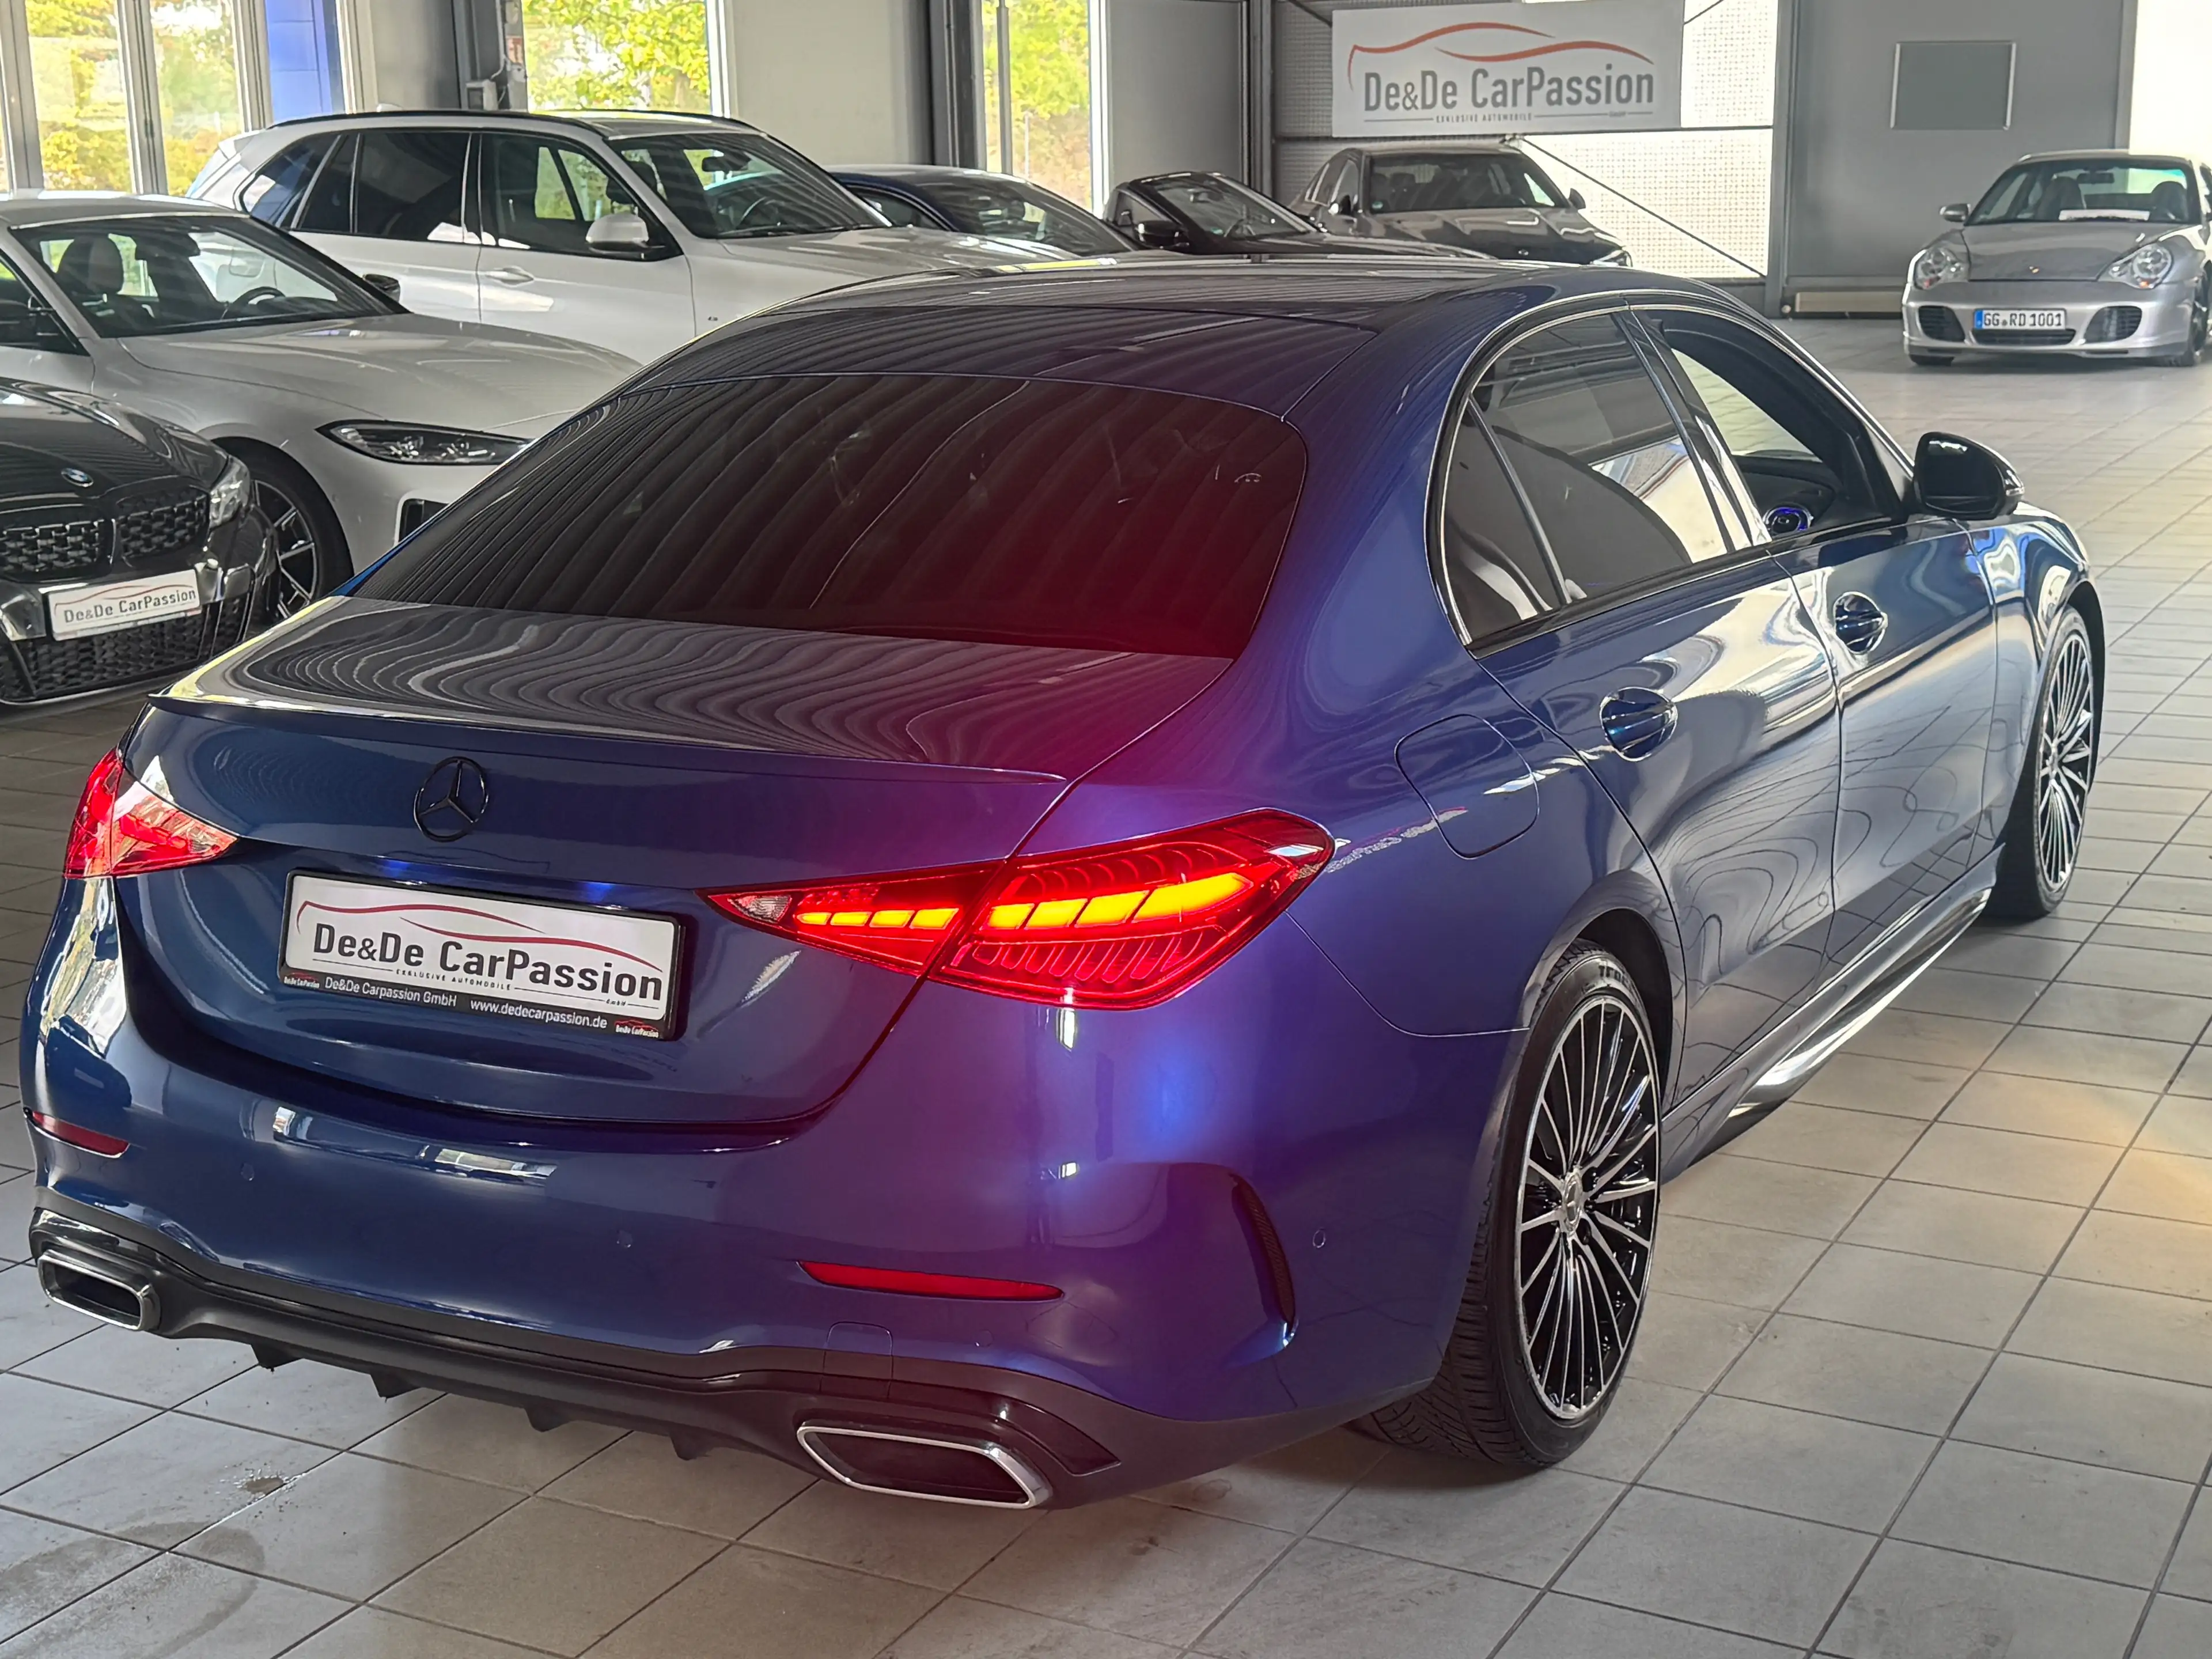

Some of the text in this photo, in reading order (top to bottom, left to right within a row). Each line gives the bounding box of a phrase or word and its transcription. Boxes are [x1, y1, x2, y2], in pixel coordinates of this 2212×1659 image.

[1365, 63, 1653, 111] De&De CarPassion
[1983, 312, 2000, 327] GG
[63, 604, 113, 623] De&De
[118, 589, 196, 613] CarPassion
[313, 923, 663, 1001] De&De CarPassion
[324, 976, 457, 1007] De&De Carpassion GmbH
[470, 999, 608, 1029] www.dedecarpassion.de
